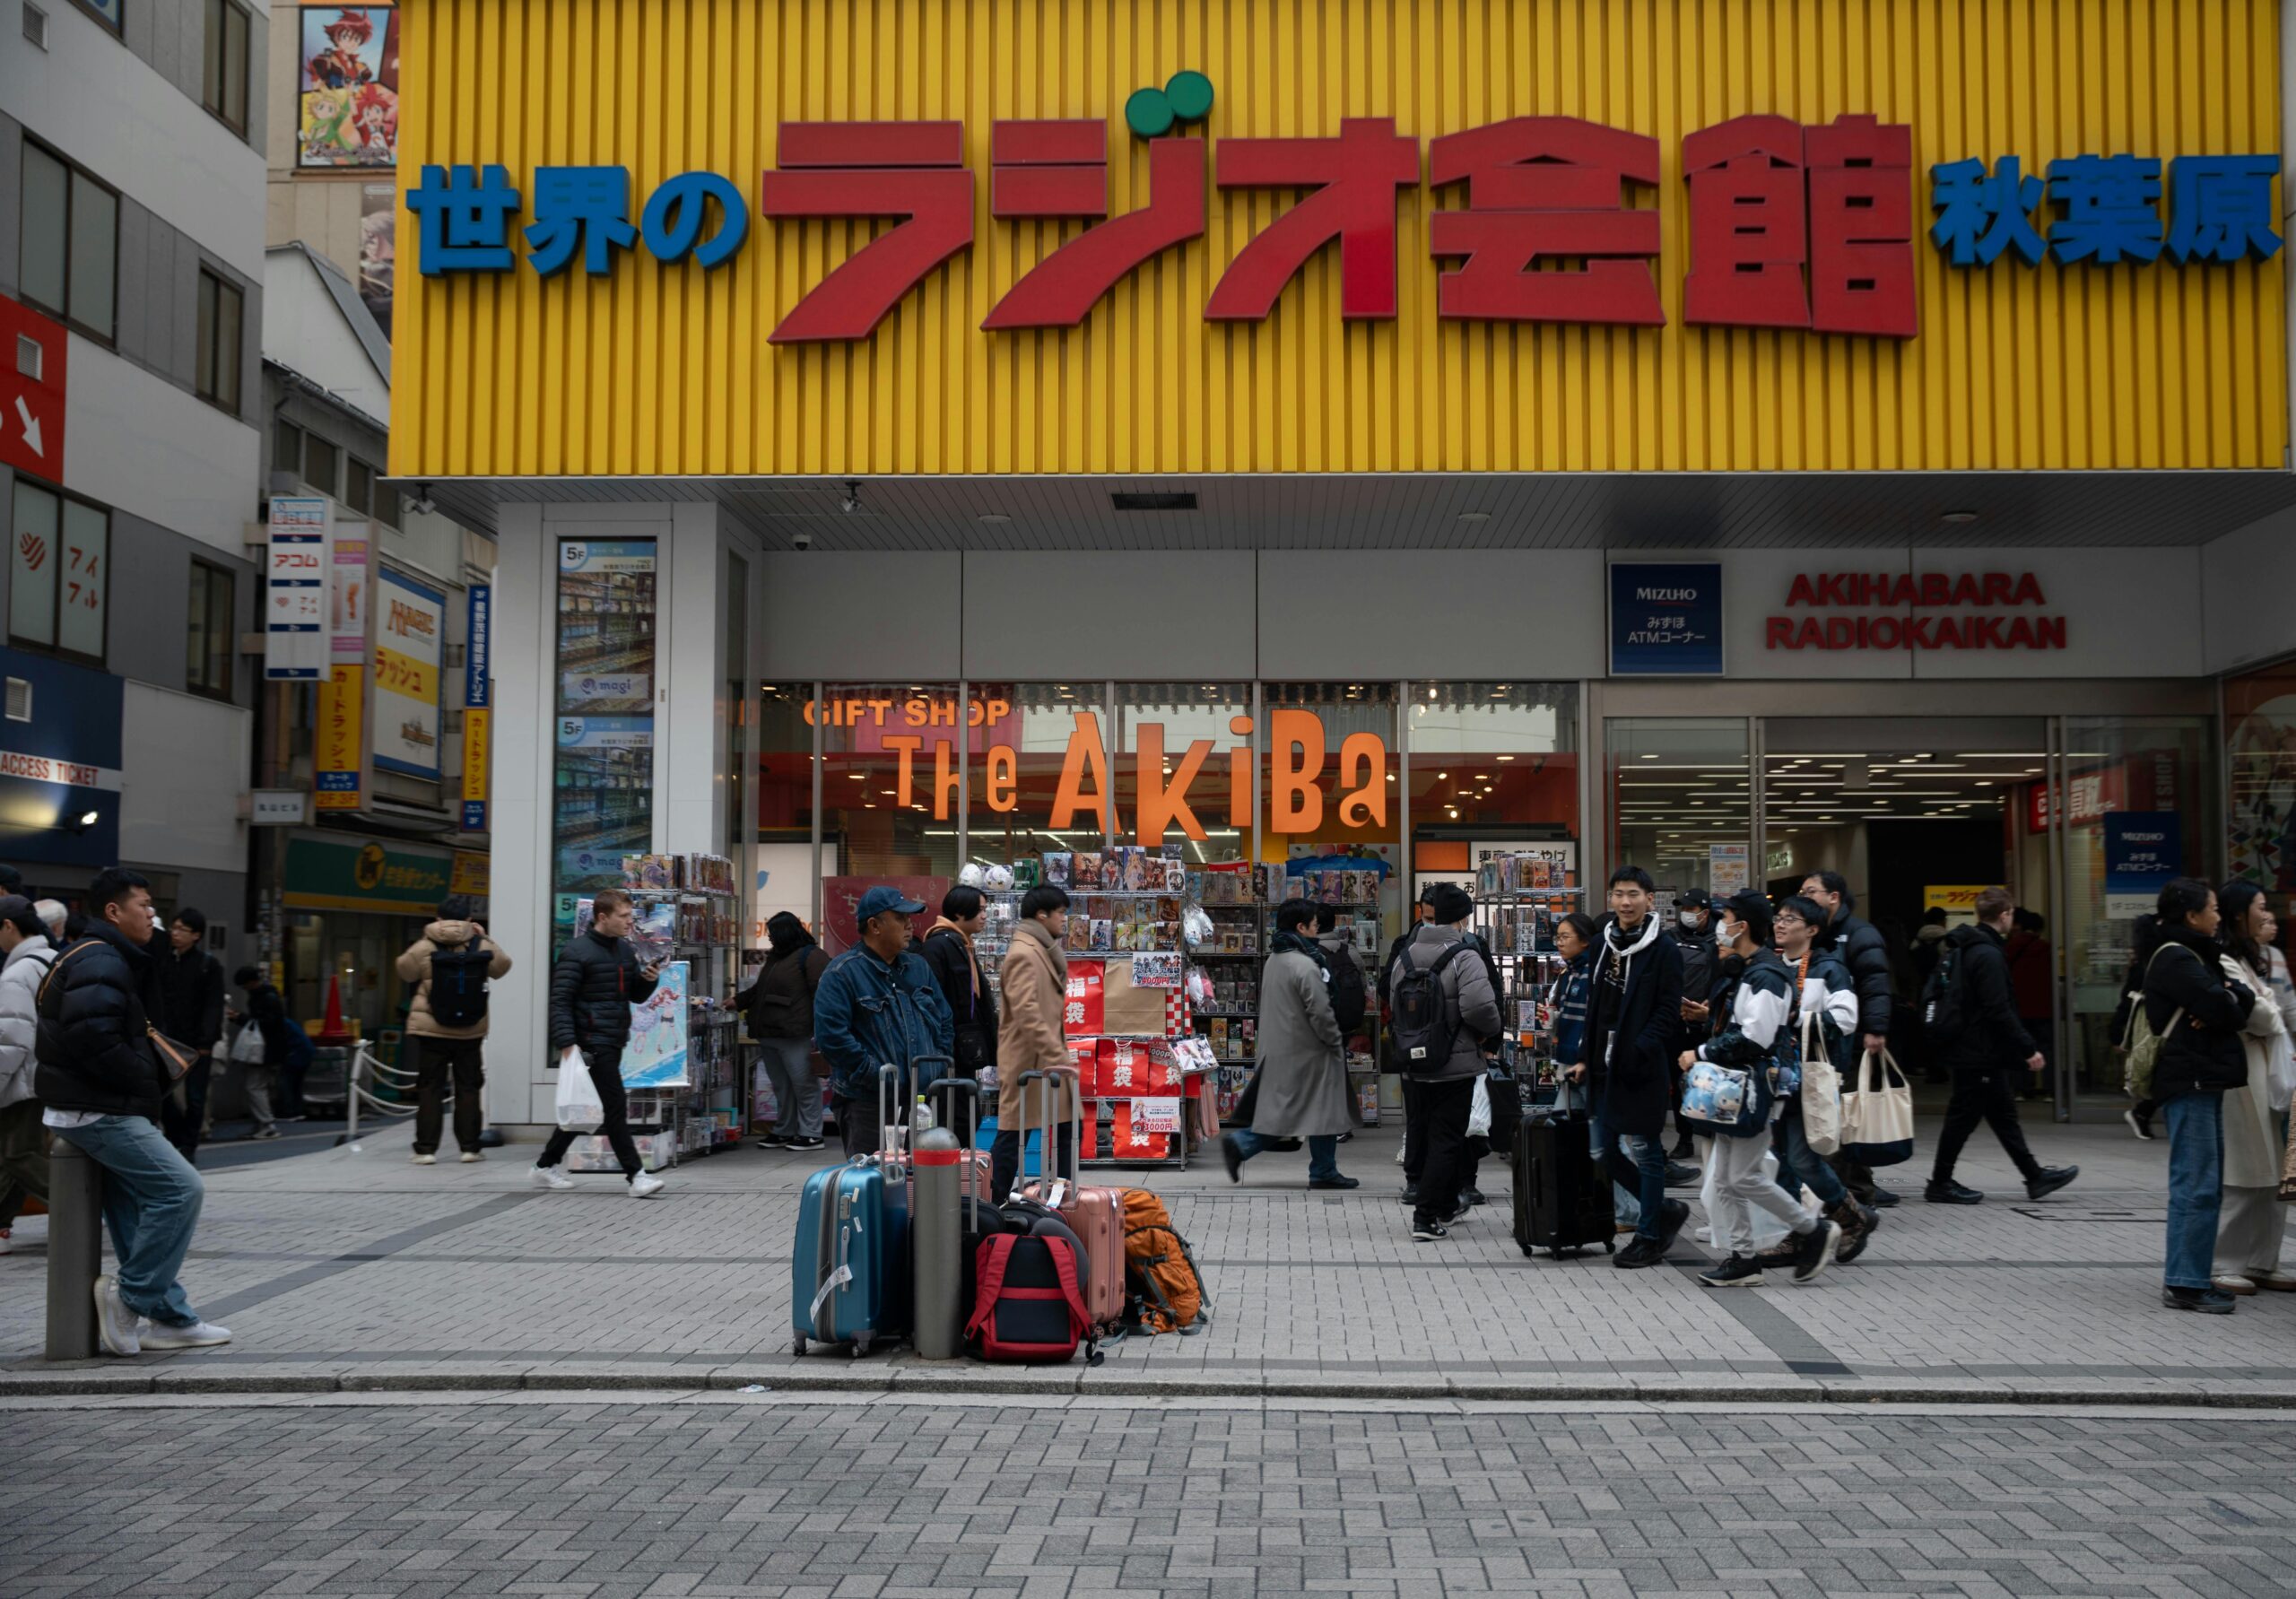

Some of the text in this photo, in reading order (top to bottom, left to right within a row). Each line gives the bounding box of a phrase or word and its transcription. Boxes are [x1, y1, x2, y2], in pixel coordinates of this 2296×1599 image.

[406, 70, 2283, 346] 世界の ラジオ会館 秋葉原
[274, 554, 318, 567] アコム
[566, 547, 585, 561] 5F
[1637, 587, 1697, 602] MIZUHO
[1785, 573, 2045, 606] AKIHABARA
[1648, 616, 1685, 630] みずほ
[1627, 630, 1706, 644] ATMコーナー
[1766, 616, 2066, 649] RADIOKAIKAN
[599, 680, 631, 695] magi
[804, 698, 1010, 728] GIFT SHOP
[563, 721, 582, 734] 5F
[0, 752, 99, 786] ACCESS TICKET
[882, 734, 1017, 821] The
[2121, 832, 2164, 841] MIZUHO
[597, 856, 623, 870] mag
[1065, 978, 1086, 1024] 福袋
[1112, 1047, 1134, 1088] 福袋
[1144, 1123, 1172, 1131] 3000円
